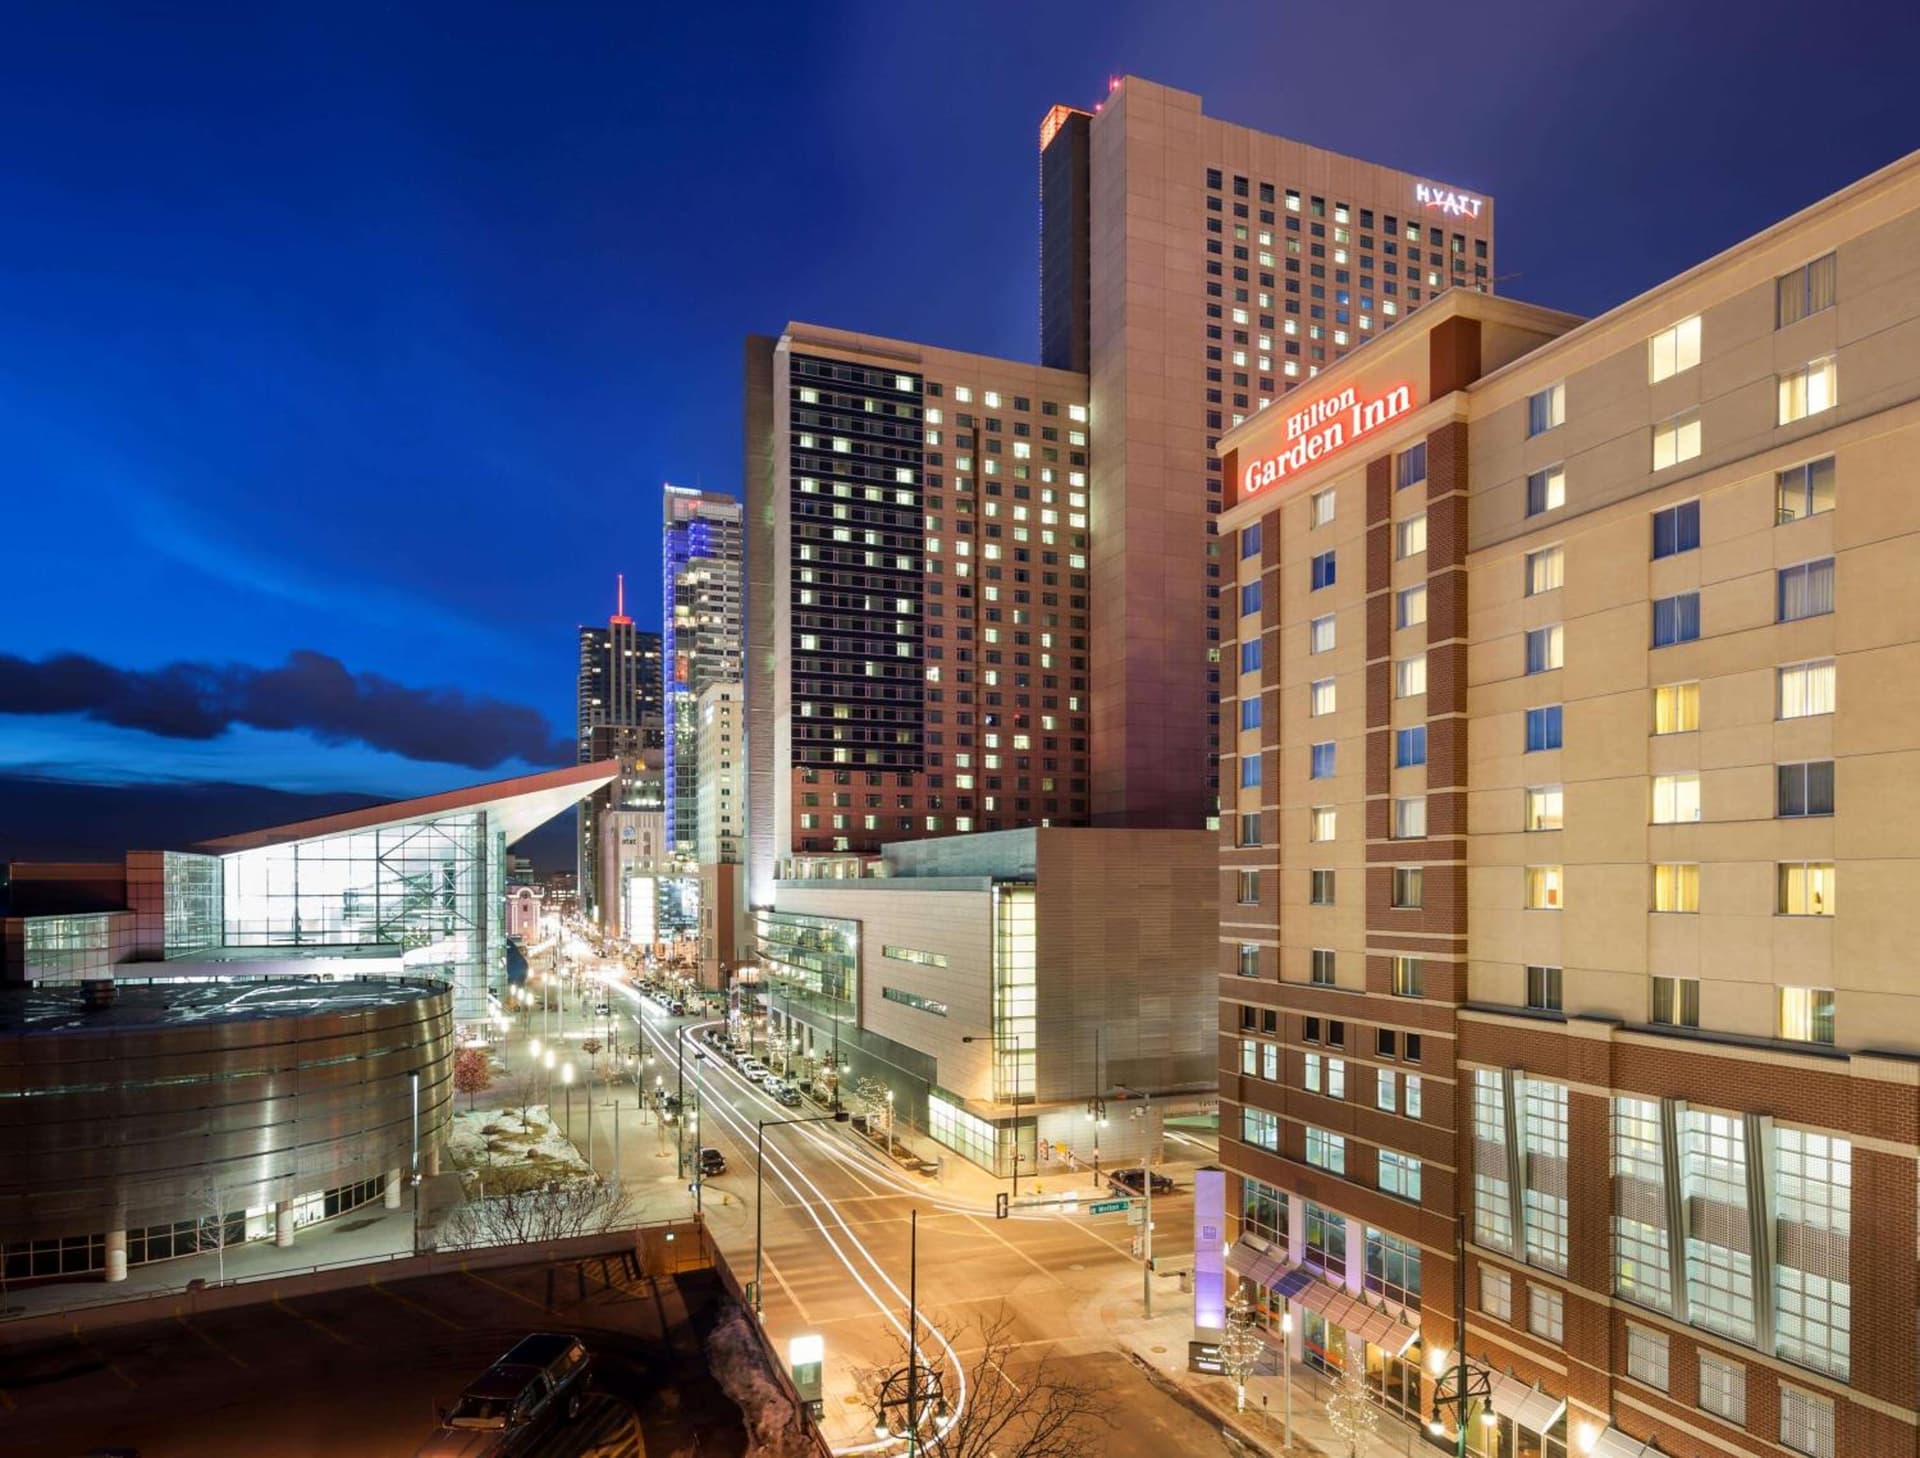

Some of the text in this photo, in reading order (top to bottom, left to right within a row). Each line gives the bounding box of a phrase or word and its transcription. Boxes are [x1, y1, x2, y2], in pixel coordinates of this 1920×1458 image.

[1416, 183, 1482, 217] HYATT
[1244, 384, 1411, 493] Garden Inn
[1286, 386, 1356, 441] Hilton
